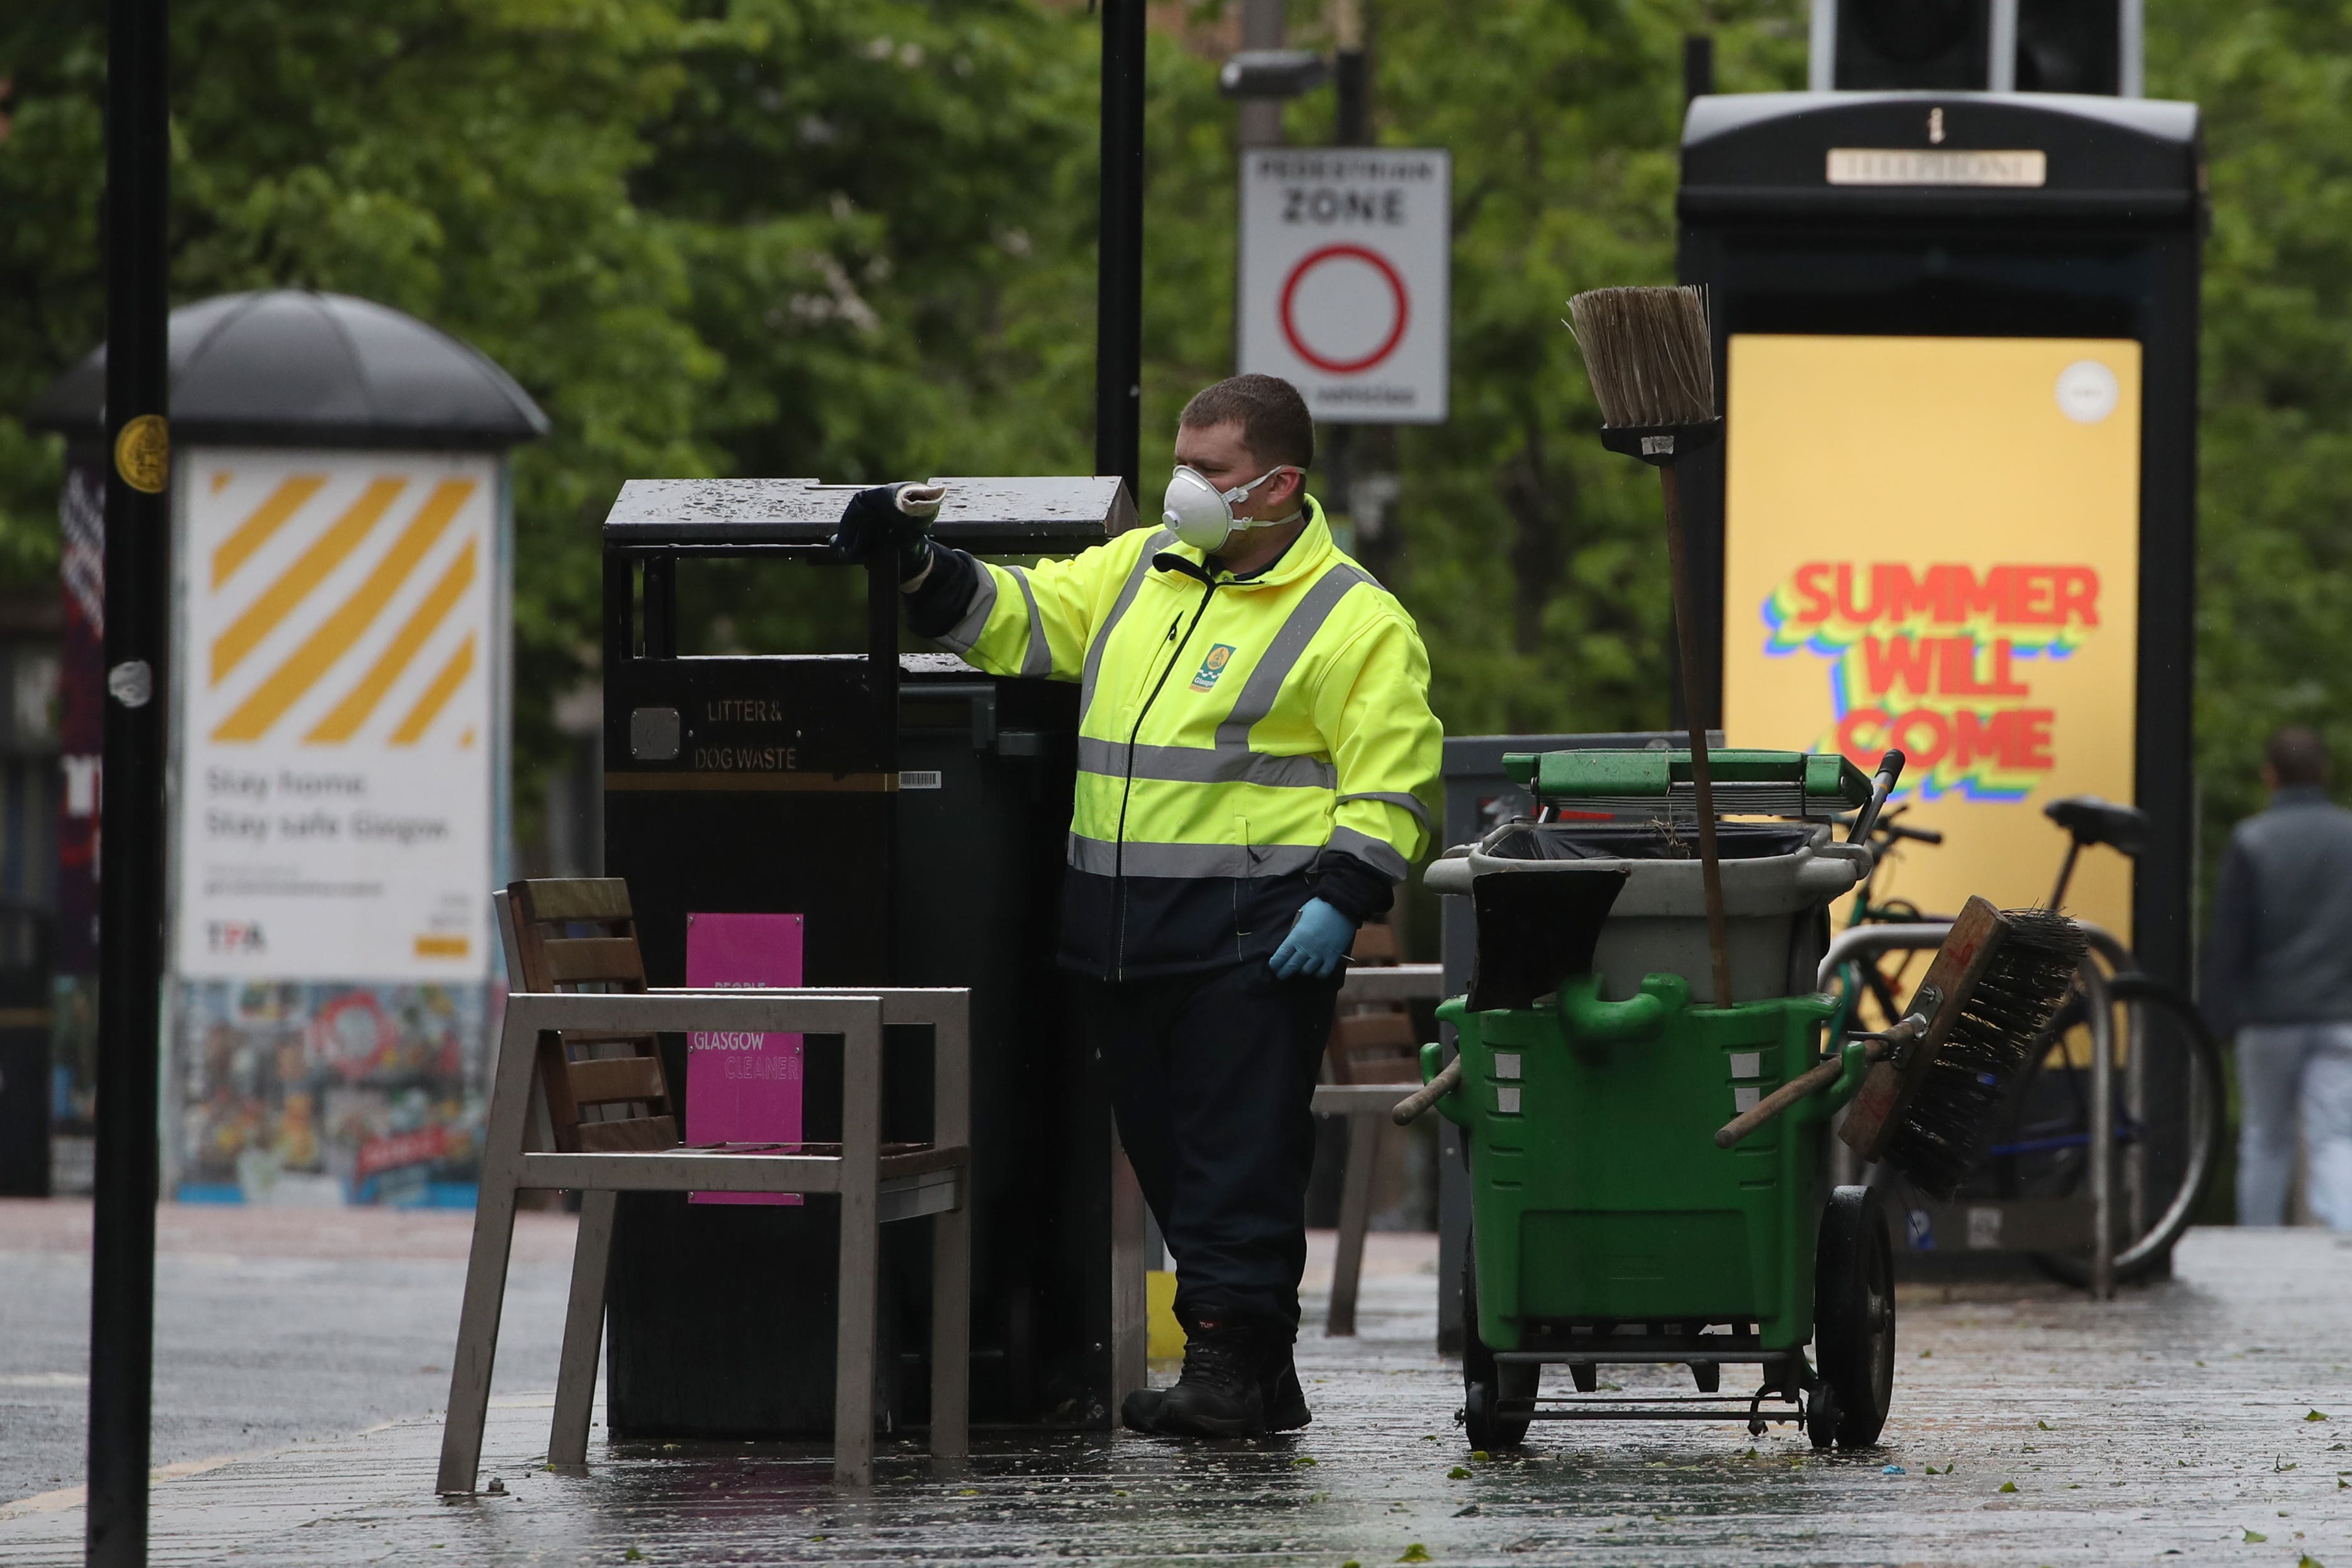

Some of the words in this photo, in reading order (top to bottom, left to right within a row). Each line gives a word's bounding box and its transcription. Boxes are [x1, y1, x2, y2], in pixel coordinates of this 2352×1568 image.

[1259, 159, 1433, 180] PEDESTRIAN
[1283, 188, 1406, 223] ZONE
[1792, 560, 2102, 625] SUMMER
[1863, 635, 2029, 696] WILL
[707, 700, 766, 722] LITTER
[771, 700, 782, 722] &
[1836, 707, 2055, 769] COME
[695, 747, 732, 770] DOG
[736, 747, 797, 770] WASTE
[207, 770, 270, 798] Stay
[207, 811, 270, 841] Stay
[280, 811, 340, 837] safe
[694, 1032, 764, 1051] GLASGOW
[725, 1056, 798, 1080] CLEANER
